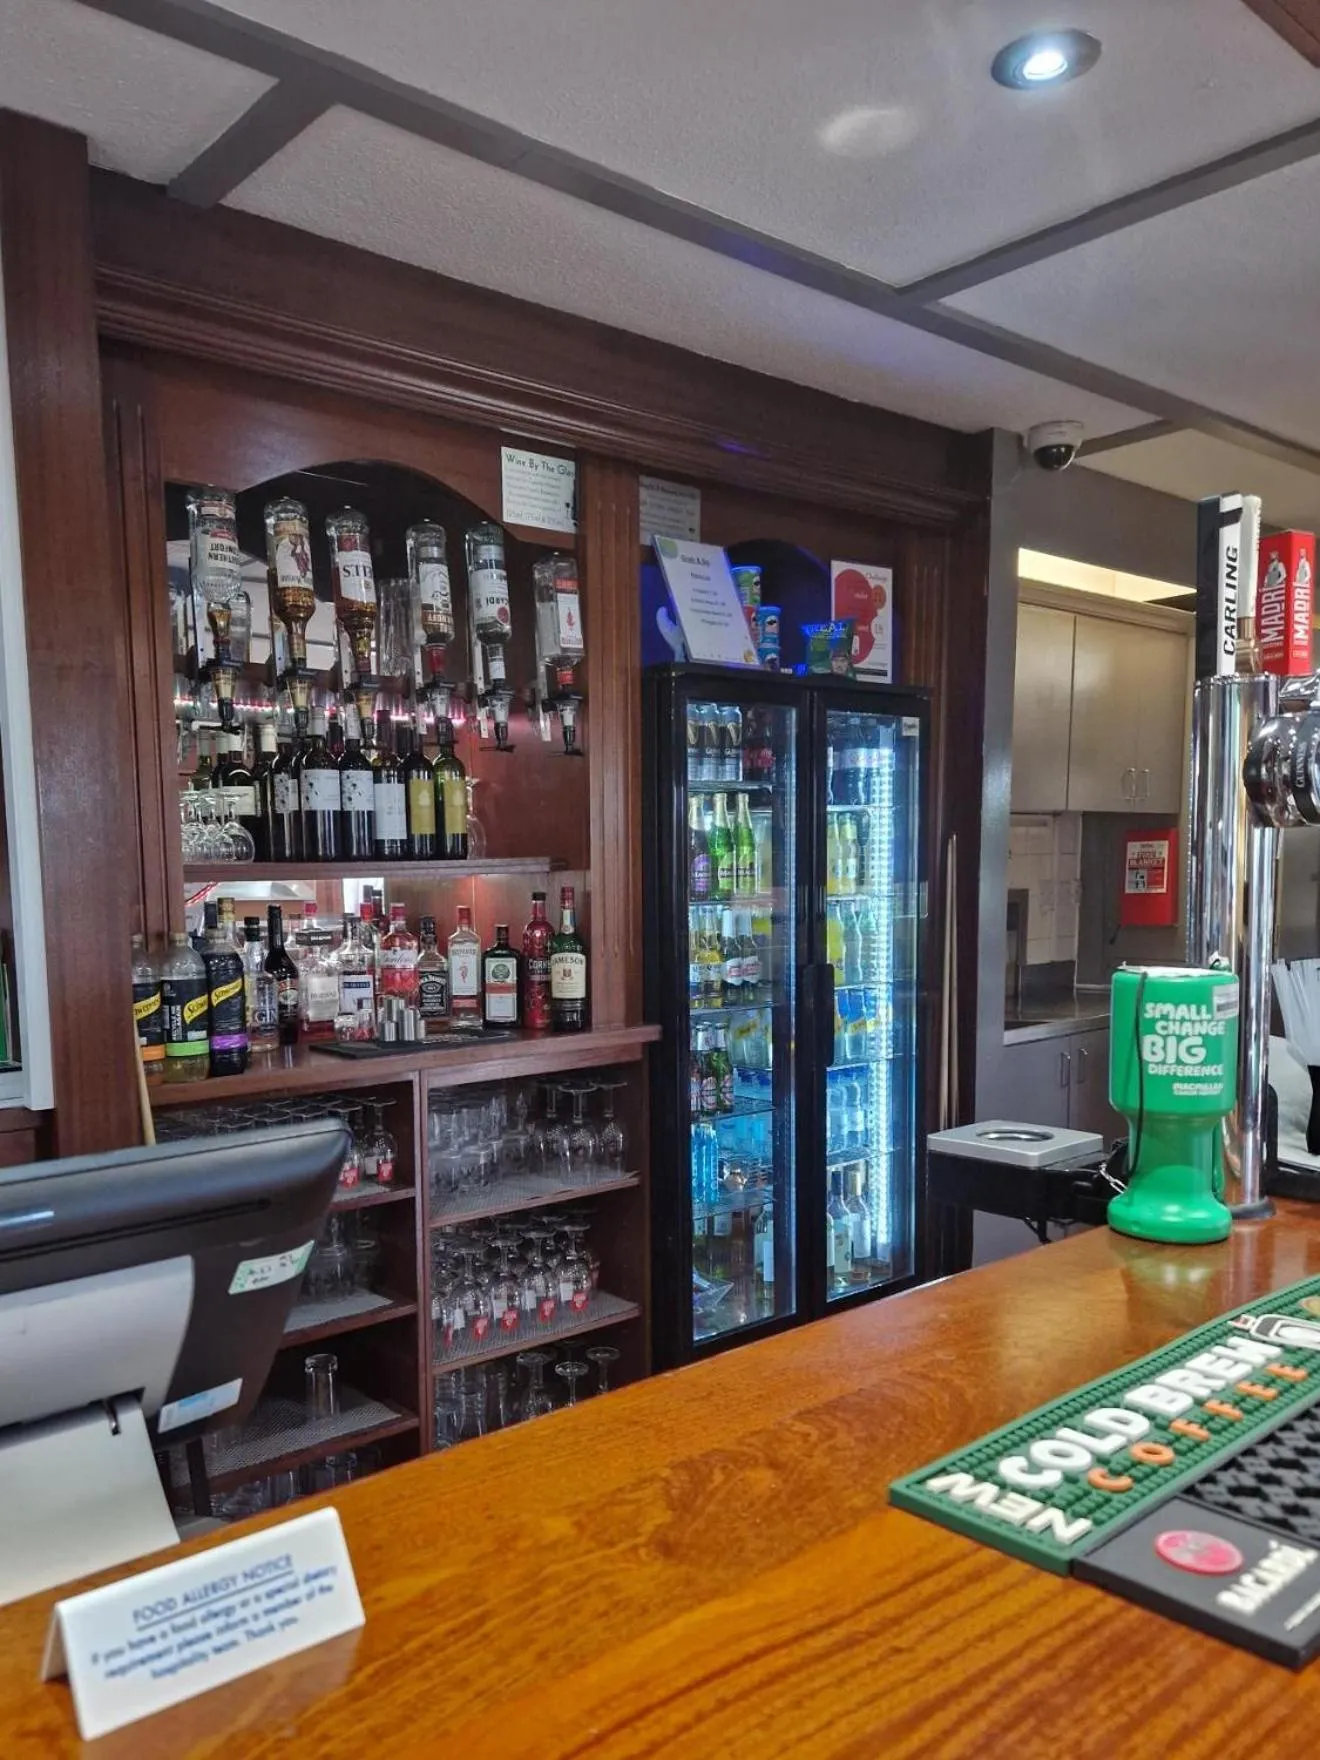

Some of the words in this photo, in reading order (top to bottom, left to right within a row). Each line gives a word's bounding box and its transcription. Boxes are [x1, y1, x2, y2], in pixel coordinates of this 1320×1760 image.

[505, 452, 525, 466] Wine
[528, 458, 538, 471] By
[542, 461, 554, 473] The
[1223, 546, 1238, 656] CARLING
[255, 1008, 277, 1023] GIN
[1144, 1002, 1212, 1020] SMALL
[1155, 1020, 1225, 1036] CHANGE
[1142, 1034, 1206, 1065] BIG
[1148, 1063, 1224, 1077] DIFFERENCE
[1000, 1407, 1151, 1489] COLD
[1124, 1336, 1285, 1418] BREW
[1087, 1362, 1308, 1493] COFFEE
[925, 1471, 1093, 1546] NEW
[132, 1597, 177, 1623] FOOD
[183, 1575, 238, 1605] ALLERGY
[242, 1553, 293, 1583] NOTICE
[127, 1635, 156, 1651] have
[170, 1615, 198, 1635] food
[200, 1605, 236, 1625] allergy
